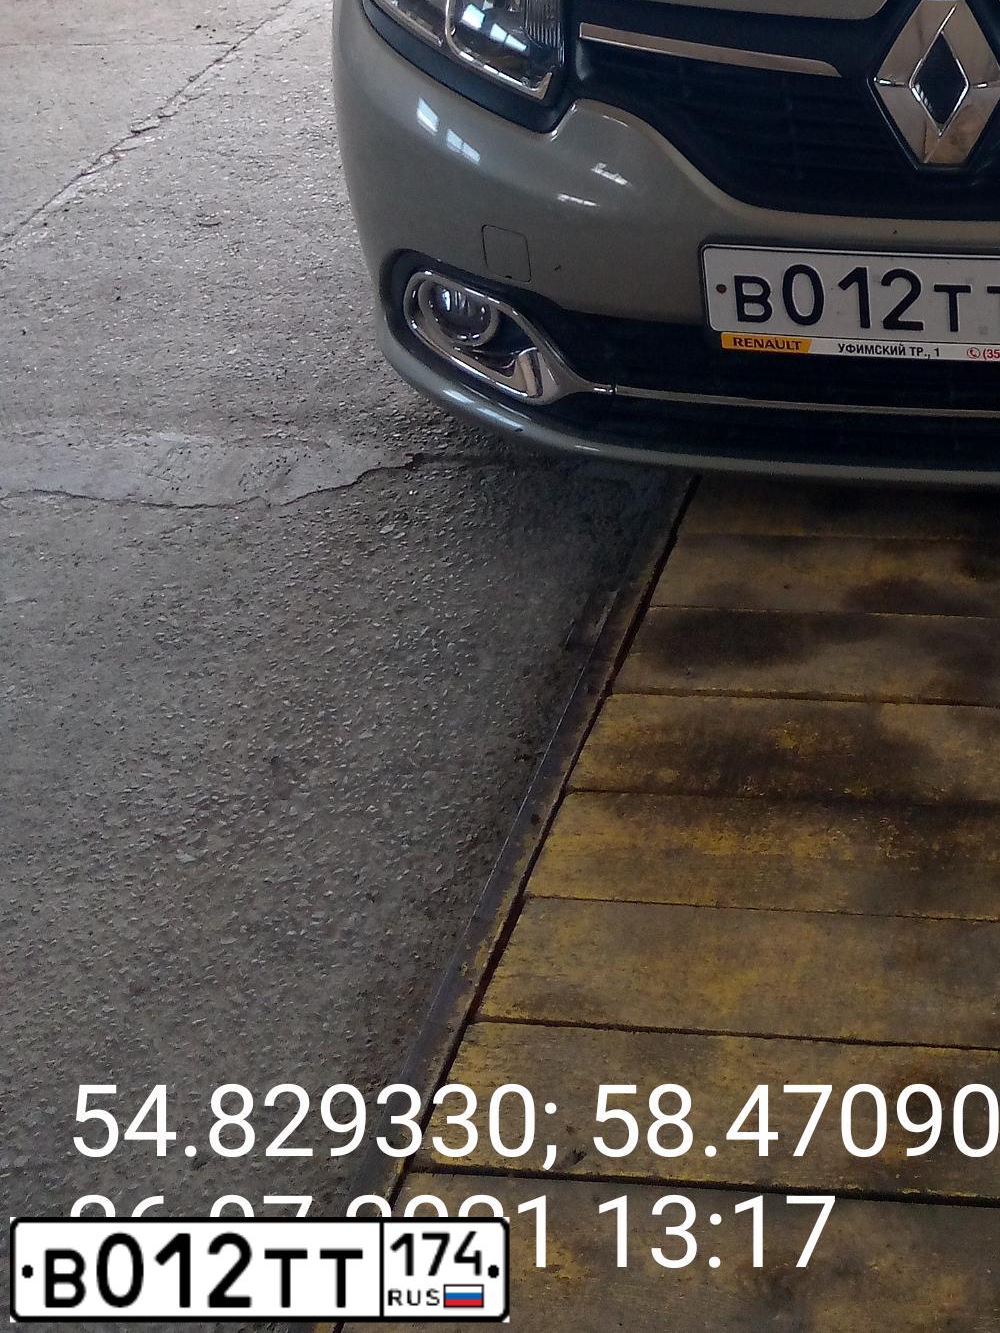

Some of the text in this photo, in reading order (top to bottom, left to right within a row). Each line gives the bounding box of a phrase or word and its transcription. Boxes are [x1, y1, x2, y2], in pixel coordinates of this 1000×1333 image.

[733, 336, 802, 350] RENAULT
[838, 342, 906, 356] УФИМСКИЙ
[934, 348, 940, 357] 1
